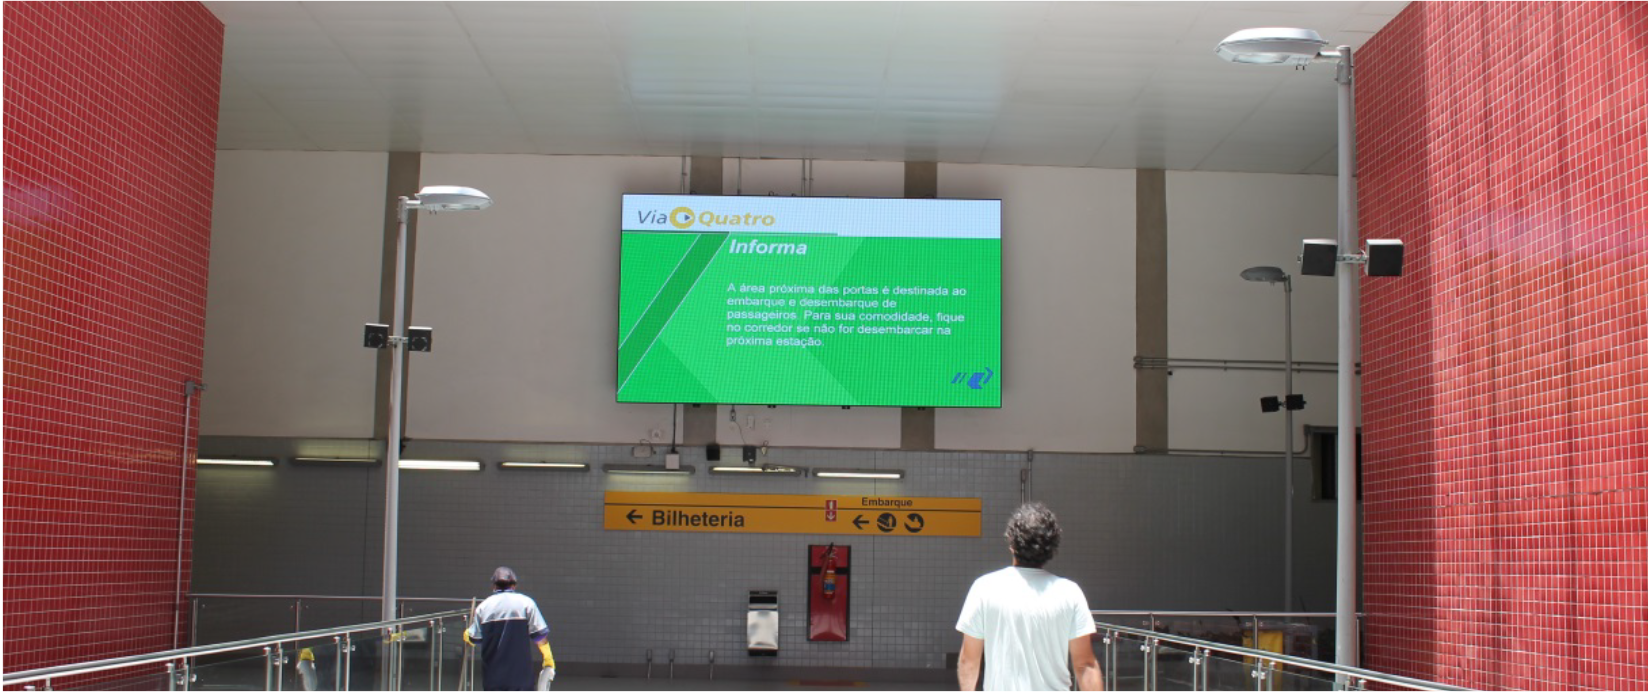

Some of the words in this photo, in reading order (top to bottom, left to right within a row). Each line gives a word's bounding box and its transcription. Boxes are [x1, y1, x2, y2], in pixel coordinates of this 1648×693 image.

[638, 209, 668, 225] Via
[699, 210, 776, 227] Quatro
[728, 238, 808, 256] Informa
[727, 282, 737, 293] A
[739, 282, 766, 293] área
[769, 284, 815, 295] próxima
[818, 284, 840, 295] das
[842, 285, 879, 296] portas
[881, 285, 891, 295] é
[892, 285, 949, 296] destinada
[951, 287, 968, 296] ao
[726, 296, 786, 308] embarque
[788, 298, 797, 307] e
[799, 297, 879, 310] desembarque
[881, 298, 897, 308] de
[803, 309, 833, 321] Para
[834, 311, 856, 321] sua
[858, 311, 933, 323] comodidade,
[936, 312, 966, 324] fique
[726, 323, 741, 333] no
[743, 323, 793, 333] corredor
[796, 324, 811, 333] se
[813, 323, 836, 334] não
[838, 323, 855, 334] for
[857, 324, 933, 335] desembarcar
[936, 326, 952, 335] na
[725, 335, 774, 347] próxima
[775, 336, 825, 349] estação.
[861, 497, 913, 508] Embarque
[652, 509, 745, 528] Bilheteria
